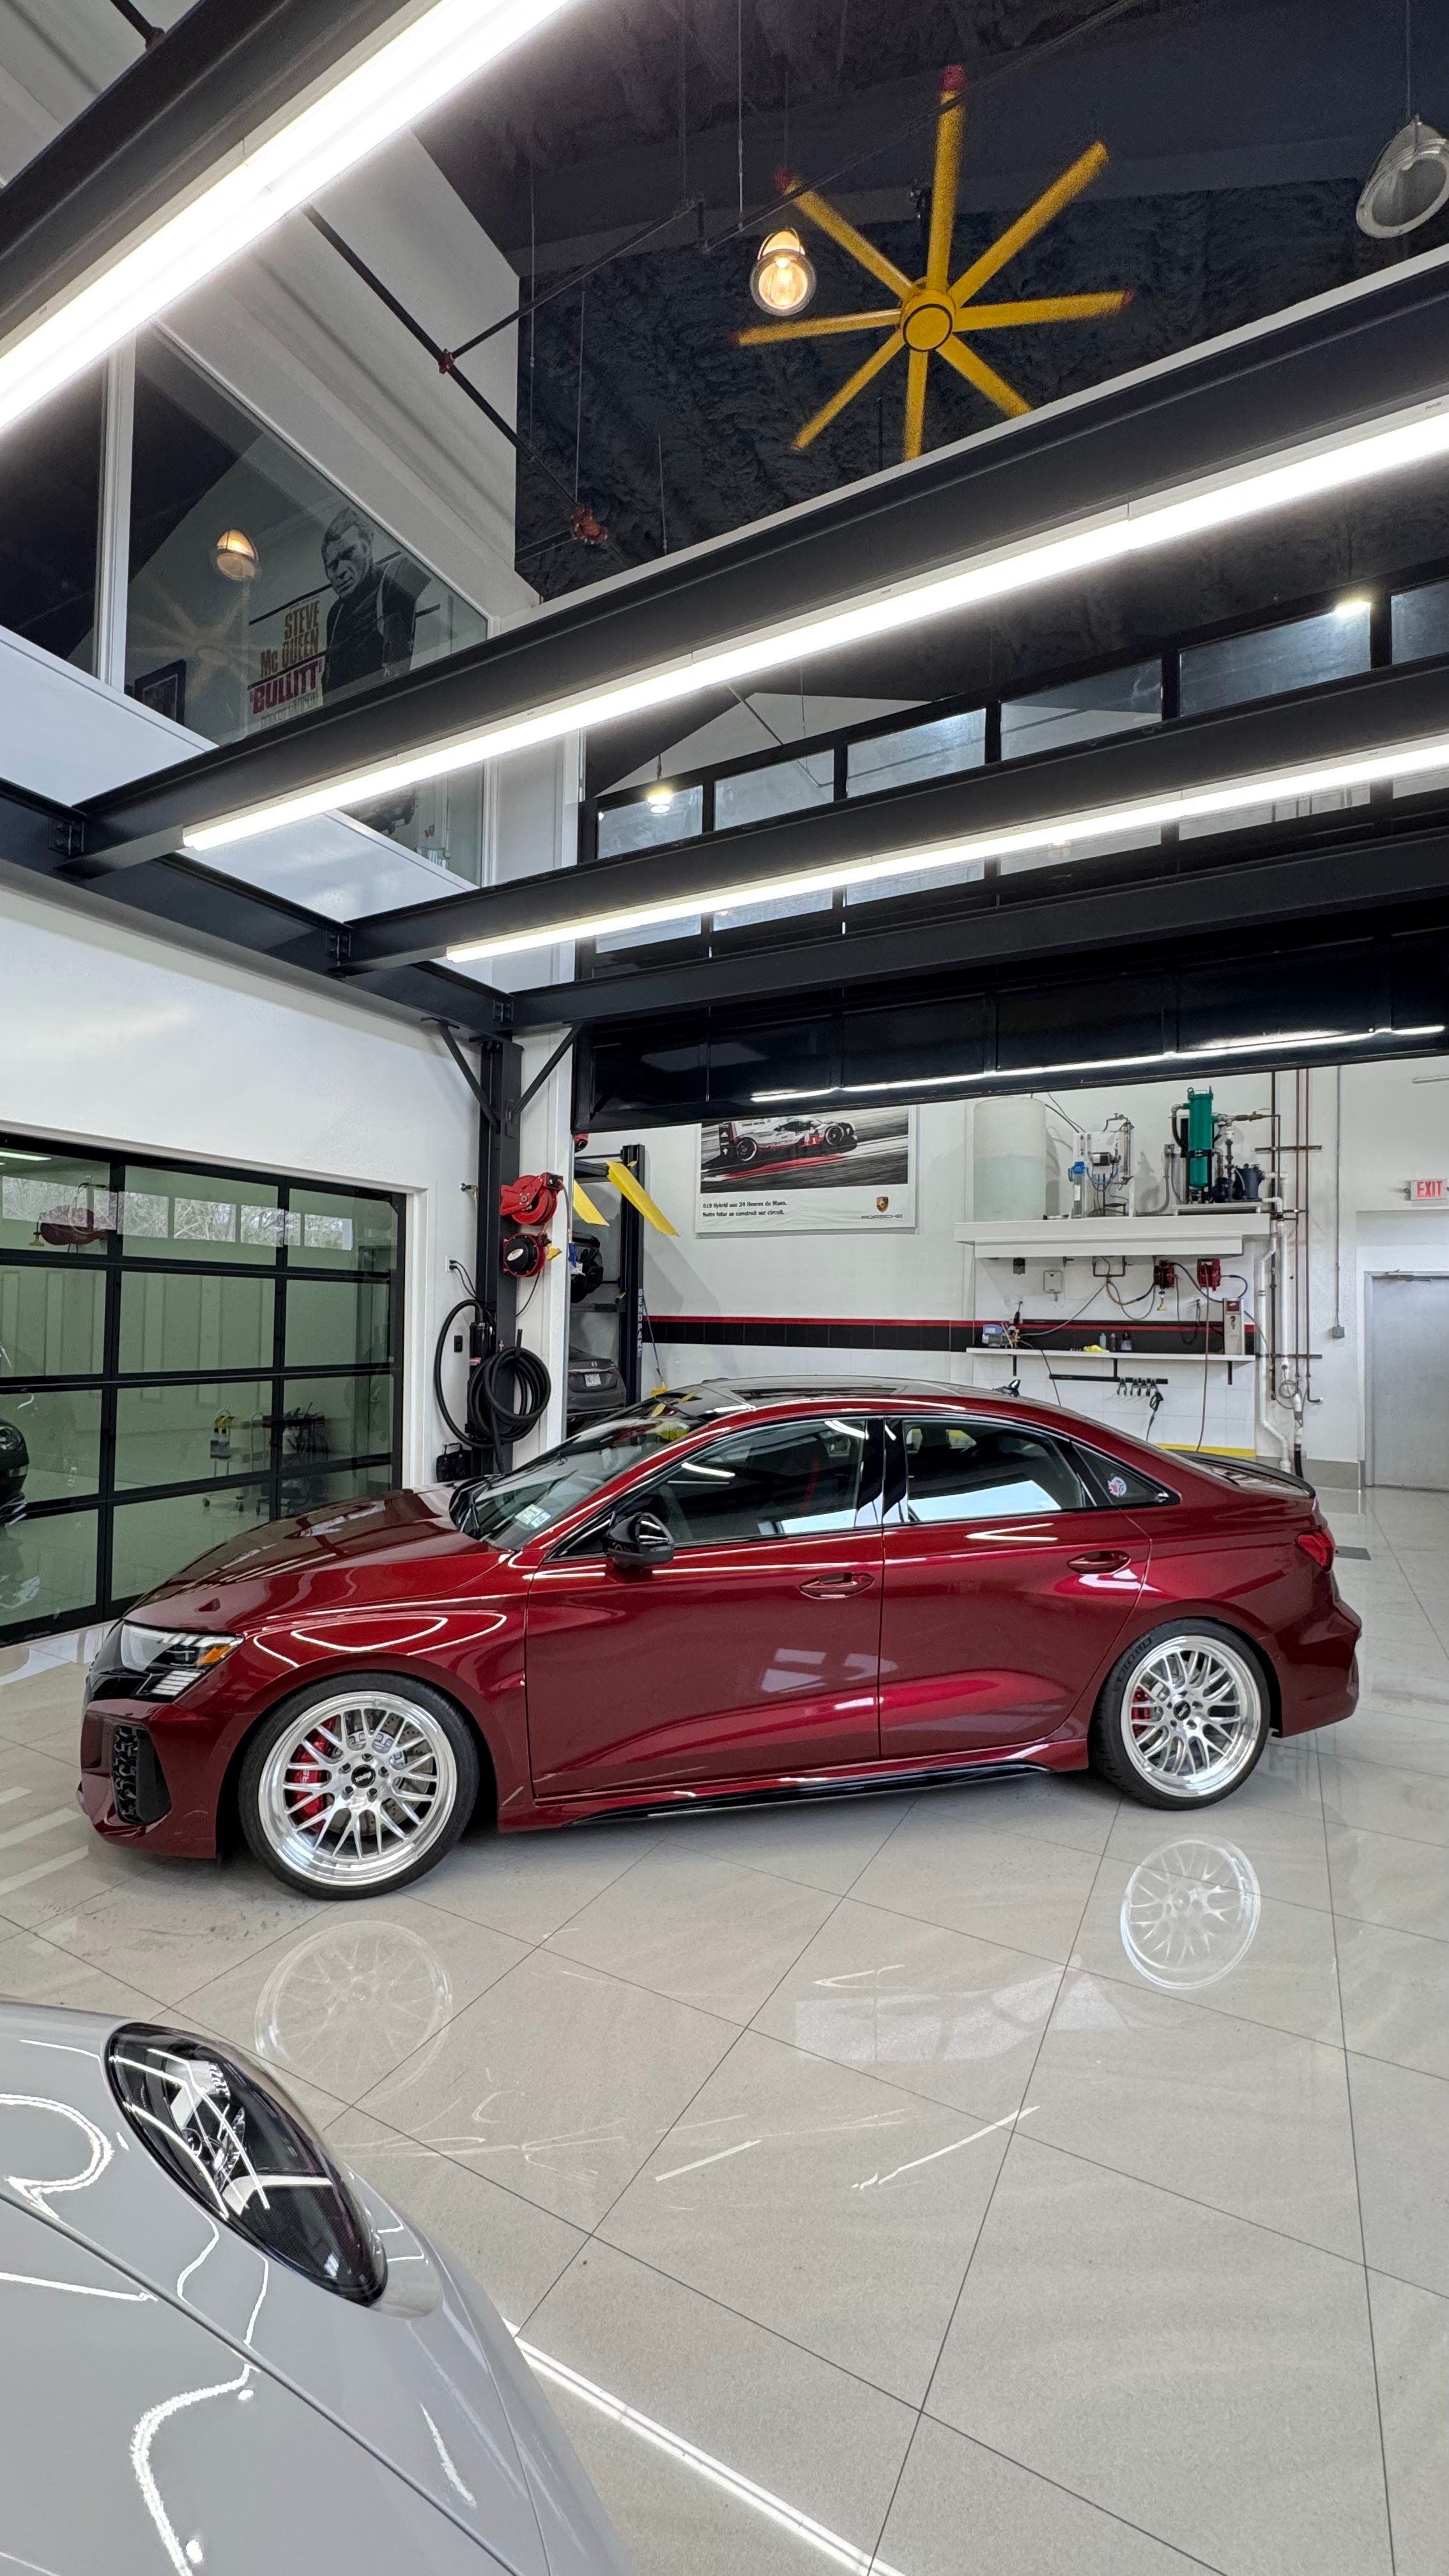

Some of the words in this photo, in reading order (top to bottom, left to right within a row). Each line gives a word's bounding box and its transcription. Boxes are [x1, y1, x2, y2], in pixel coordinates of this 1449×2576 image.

[284, 601, 319, 640] STEVE
[261, 648, 278, 678] Mc
[281, 627, 319, 668] QUEEN
[1416, 1180, 1442, 1198] EXIT
